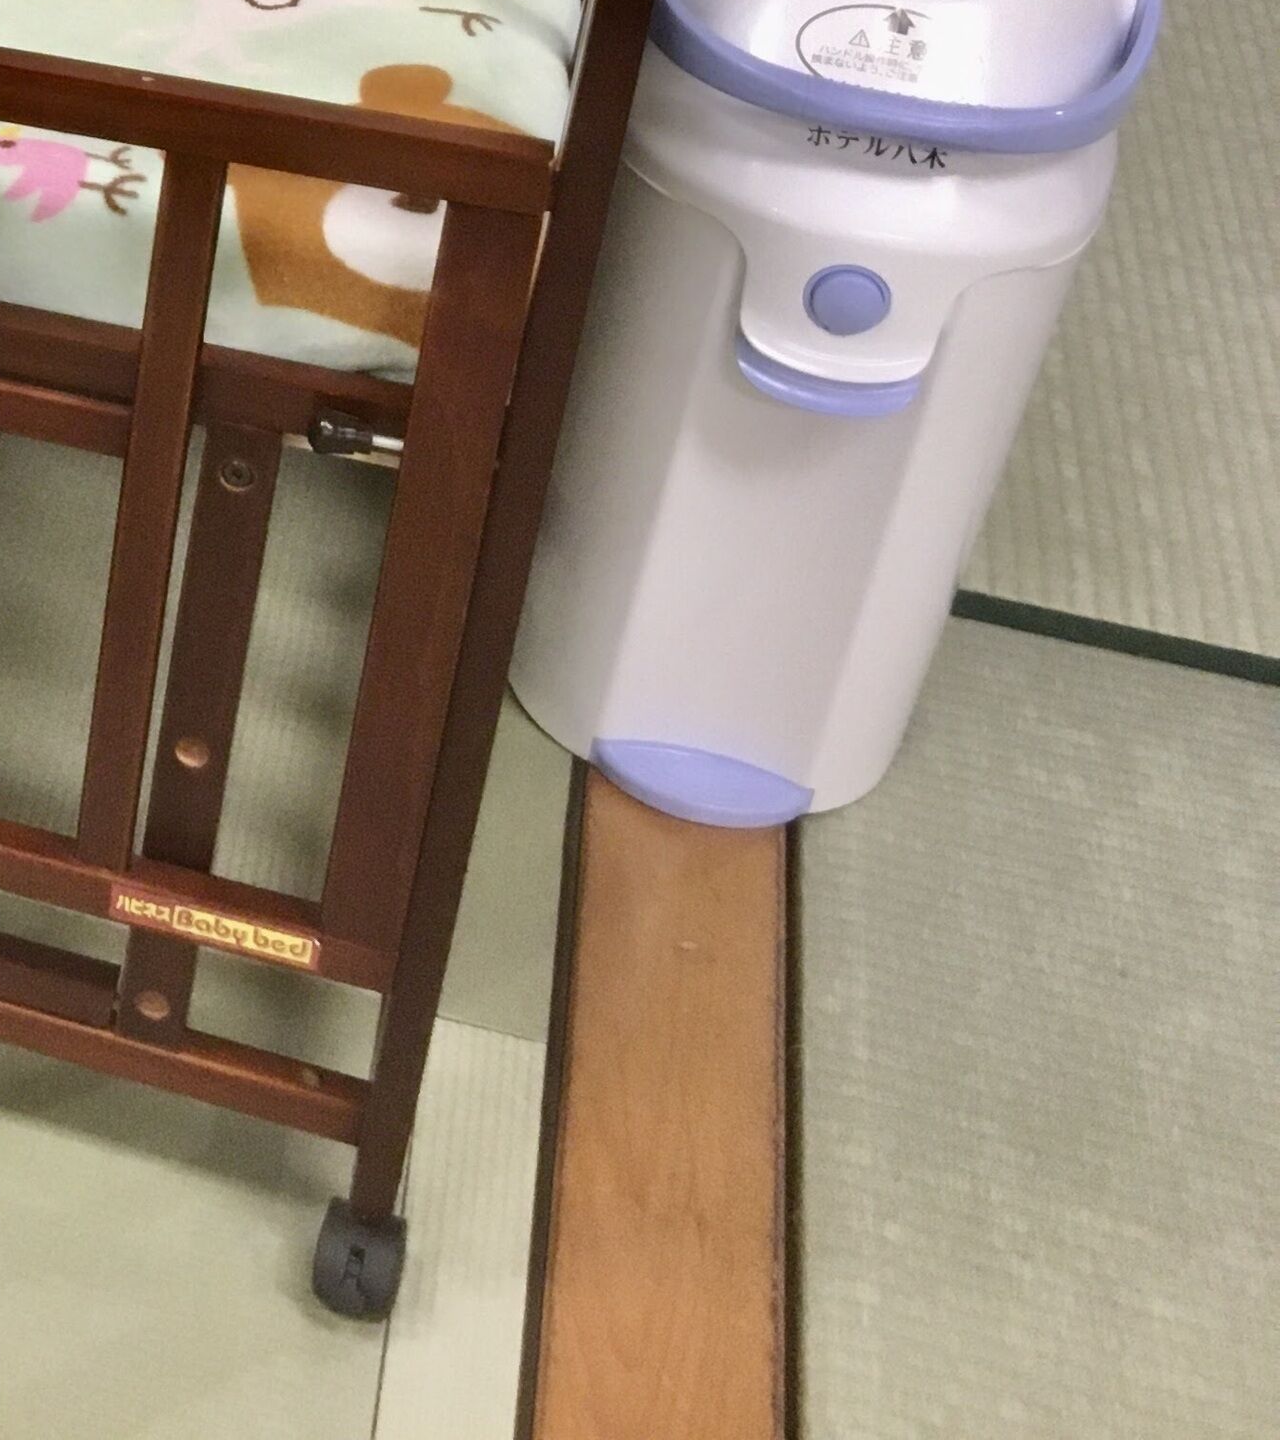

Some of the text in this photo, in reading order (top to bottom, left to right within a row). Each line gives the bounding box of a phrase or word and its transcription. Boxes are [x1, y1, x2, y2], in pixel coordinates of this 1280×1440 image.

[806, 126, 948, 169] ホテル八木
